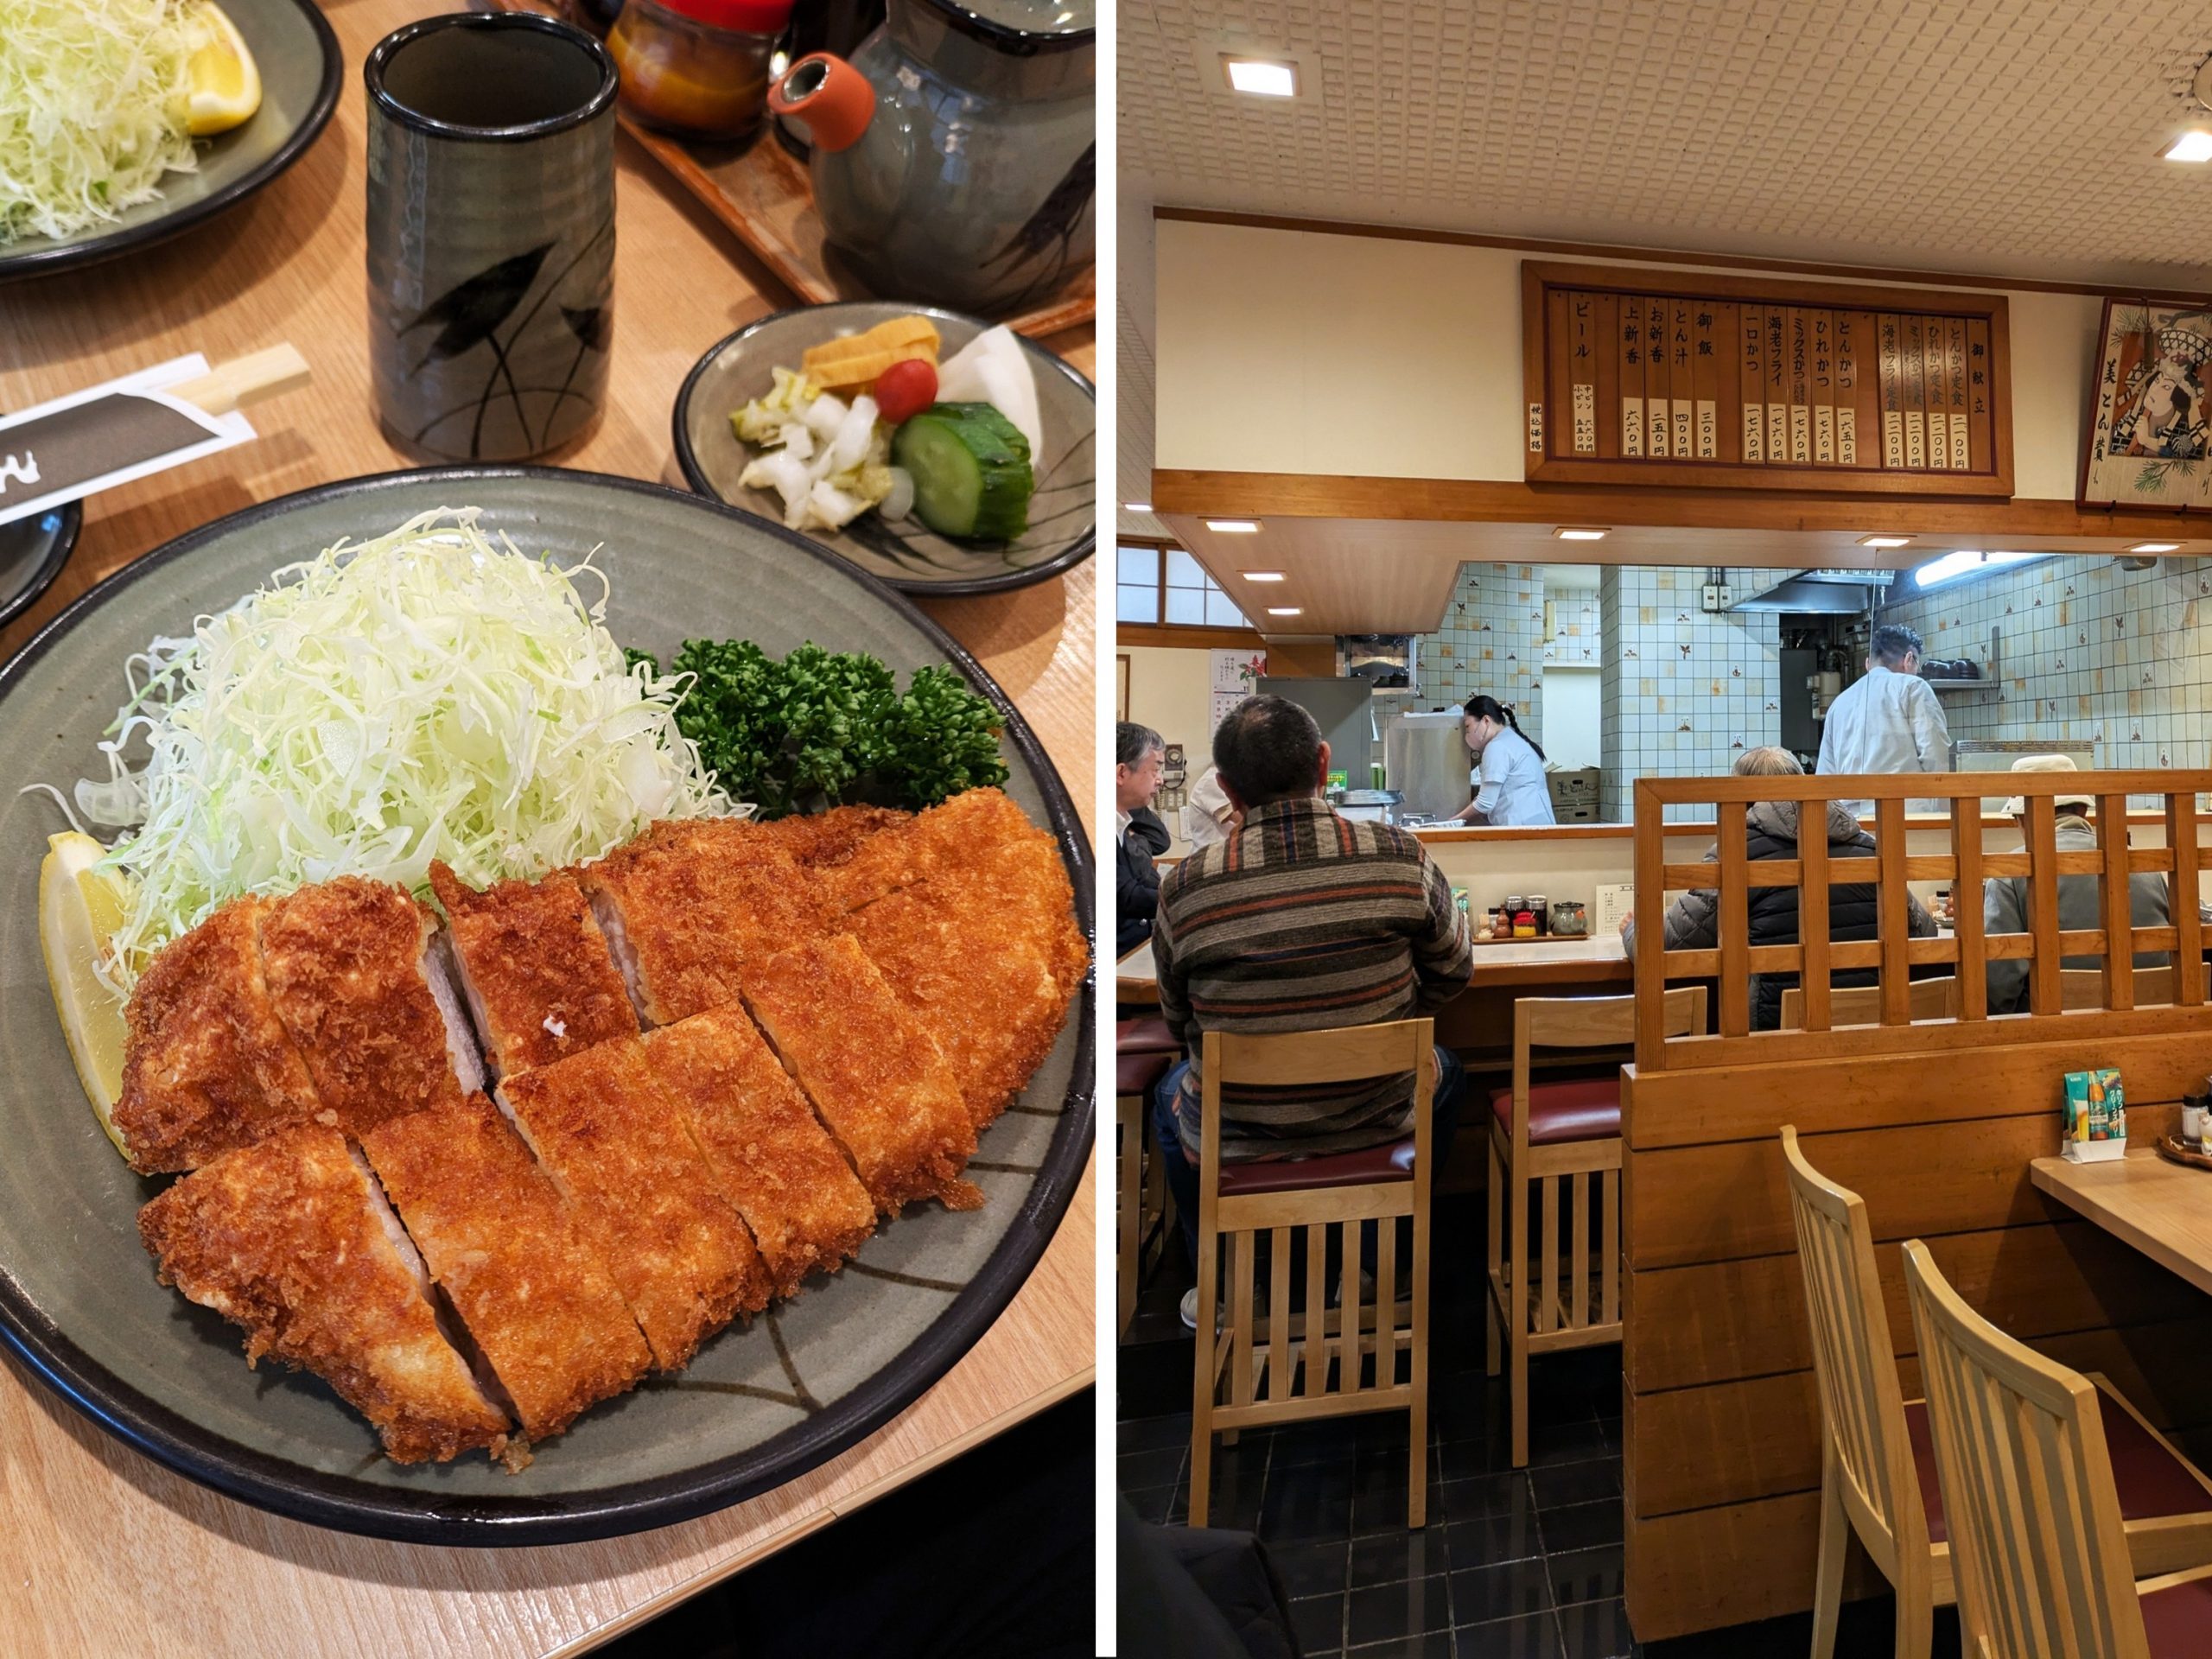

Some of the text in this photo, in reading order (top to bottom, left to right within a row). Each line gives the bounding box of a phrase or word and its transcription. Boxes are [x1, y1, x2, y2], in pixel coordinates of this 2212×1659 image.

[1574, 301, 1591, 359] ビール
[1624, 307, 1641, 365] 上新香
[1649, 307, 1664, 364] お新香
[1675, 309, 1688, 368] とん汁
[1695, 312, 1714, 356] 御飯
[1745, 316, 1759, 372] 一口かつ
[1768, 315, 1783, 387] 海老フライ
[1815, 321, 1830, 388] ひれかつ
[1839, 321, 1852, 389] とんかつ
[1882, 324, 1897, 412] 海老フライ定食
[1928, 326, 1943, 405] ひれかつ定食
[1949, 327, 1964, 406] とんかつ定食
[1971, 342, 1985, 415] 御献立
